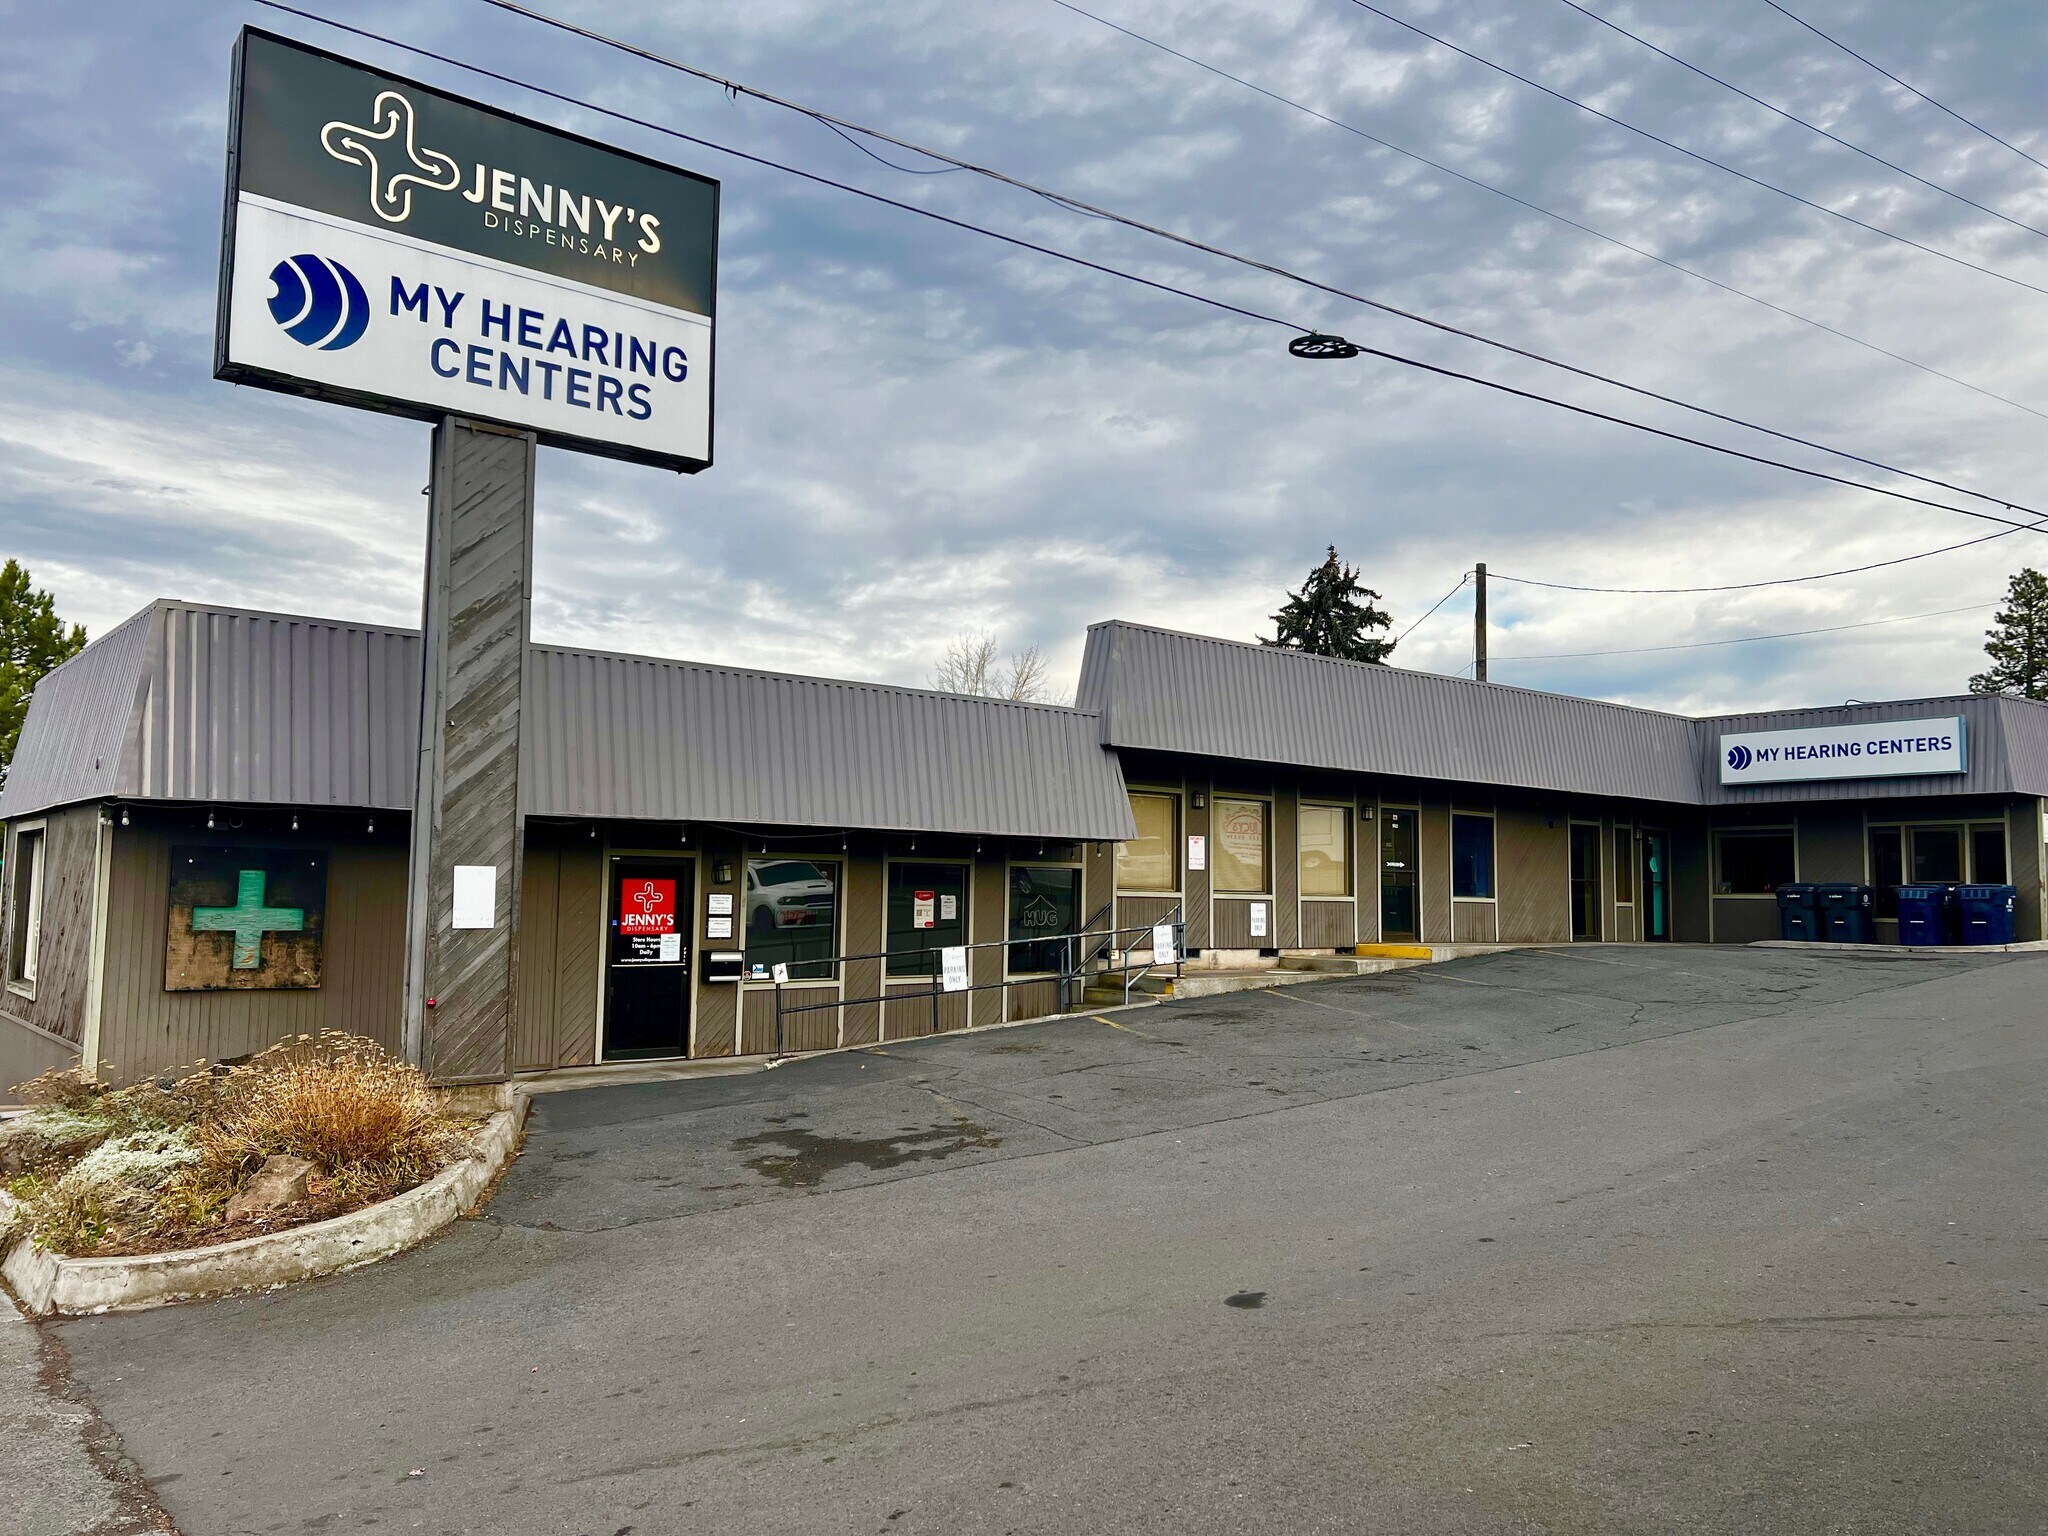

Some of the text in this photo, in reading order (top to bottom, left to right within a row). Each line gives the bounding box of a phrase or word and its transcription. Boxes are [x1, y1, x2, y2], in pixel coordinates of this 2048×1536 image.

[462, 163, 661, 254] JENNY'S
[484, 211, 639, 267] DISPENSARY
[389, 275, 688, 383] MY HEARING
[430, 337, 652, 420] CENTERS
[1756, 736, 1952, 762] MY HEARING CENTERS
[622, 914, 674, 926] JENNY'S
[1023, 910, 1058, 926] HUG
[943, 965, 965, 974] PARKING
[949, 976, 961, 984] ONLY
